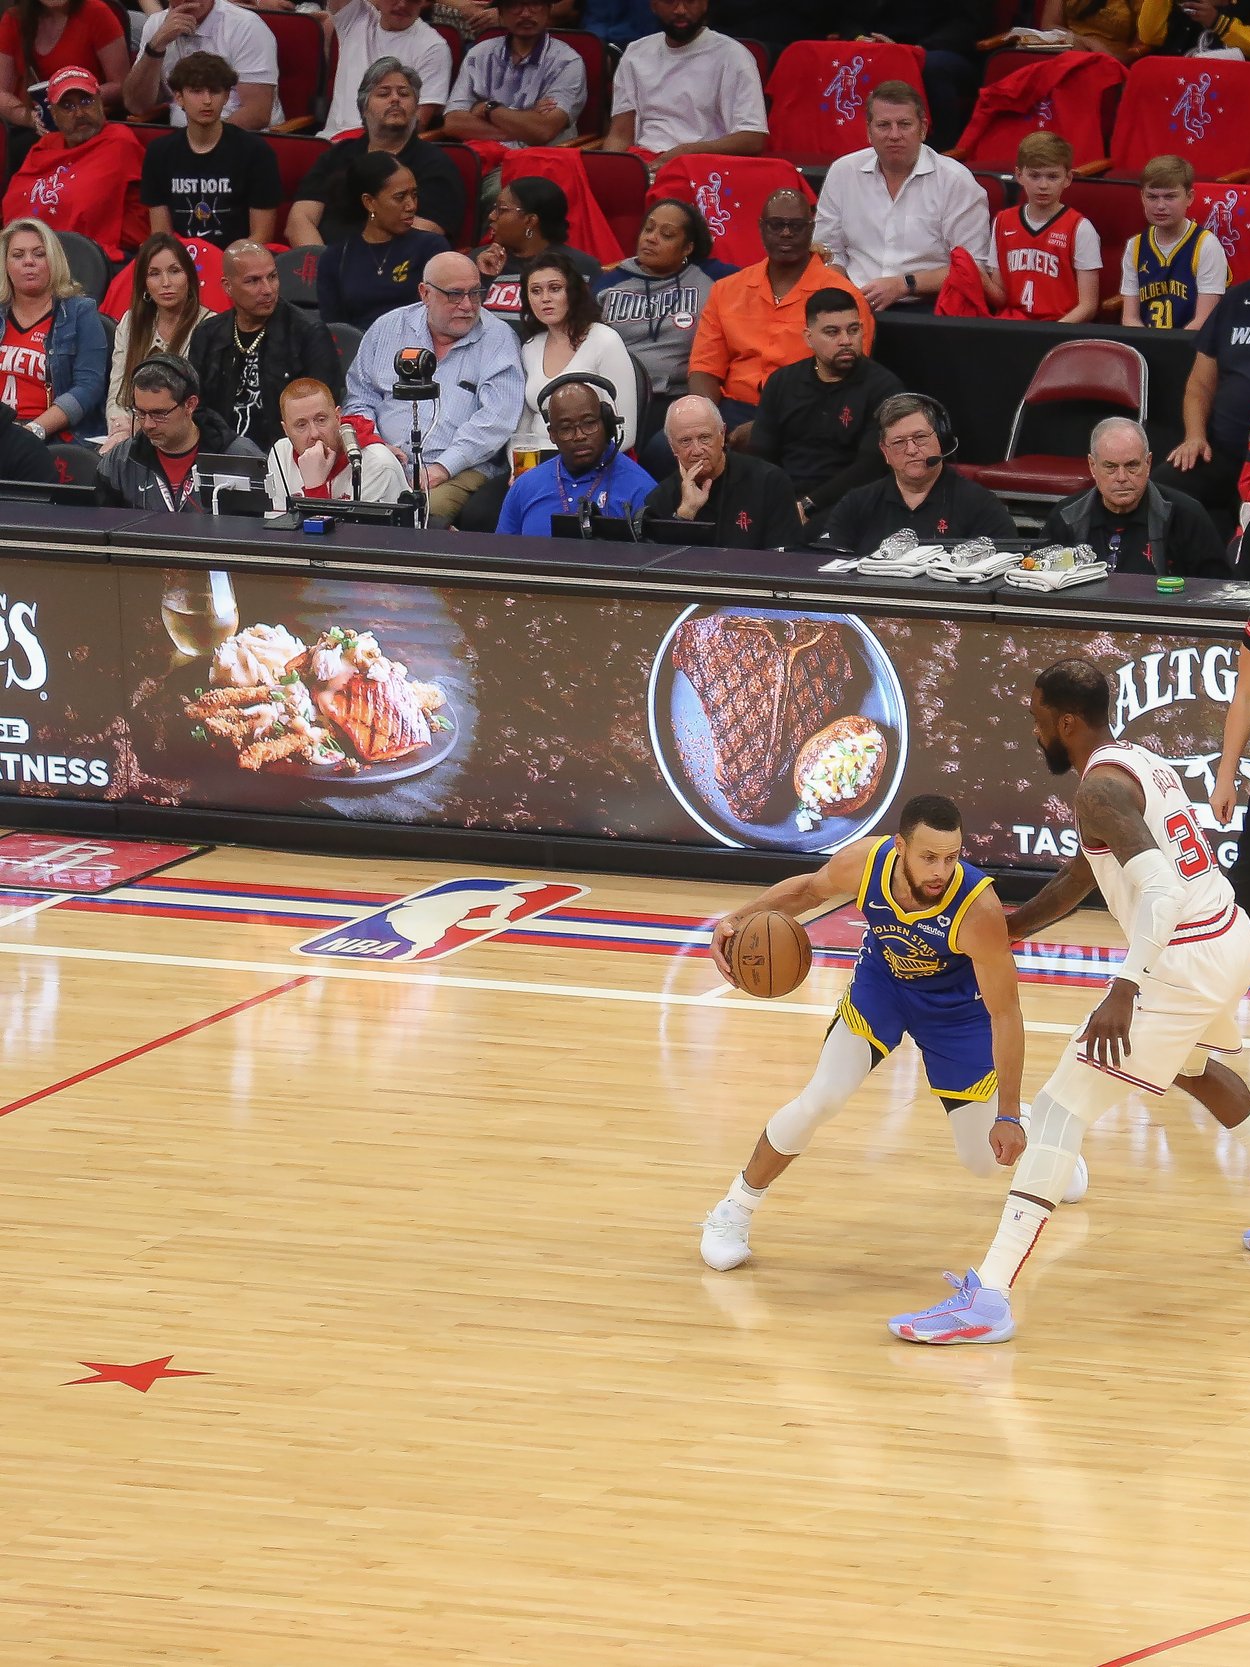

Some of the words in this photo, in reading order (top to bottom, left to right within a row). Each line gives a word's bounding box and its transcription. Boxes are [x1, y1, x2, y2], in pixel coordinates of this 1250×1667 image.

[171, 177, 199, 194] JUST
[200, 178, 219, 194] DO
[219, 178, 232, 194] IT.
[1021, 281, 1034, 312] 4
[1, 375, 18, 410] 4
[0, 752, 109, 787] TNESS
[917, 922, 946, 938] Rakuten
[315, 937, 402, 957] NBA
[911, 934, 937, 958] STATE
